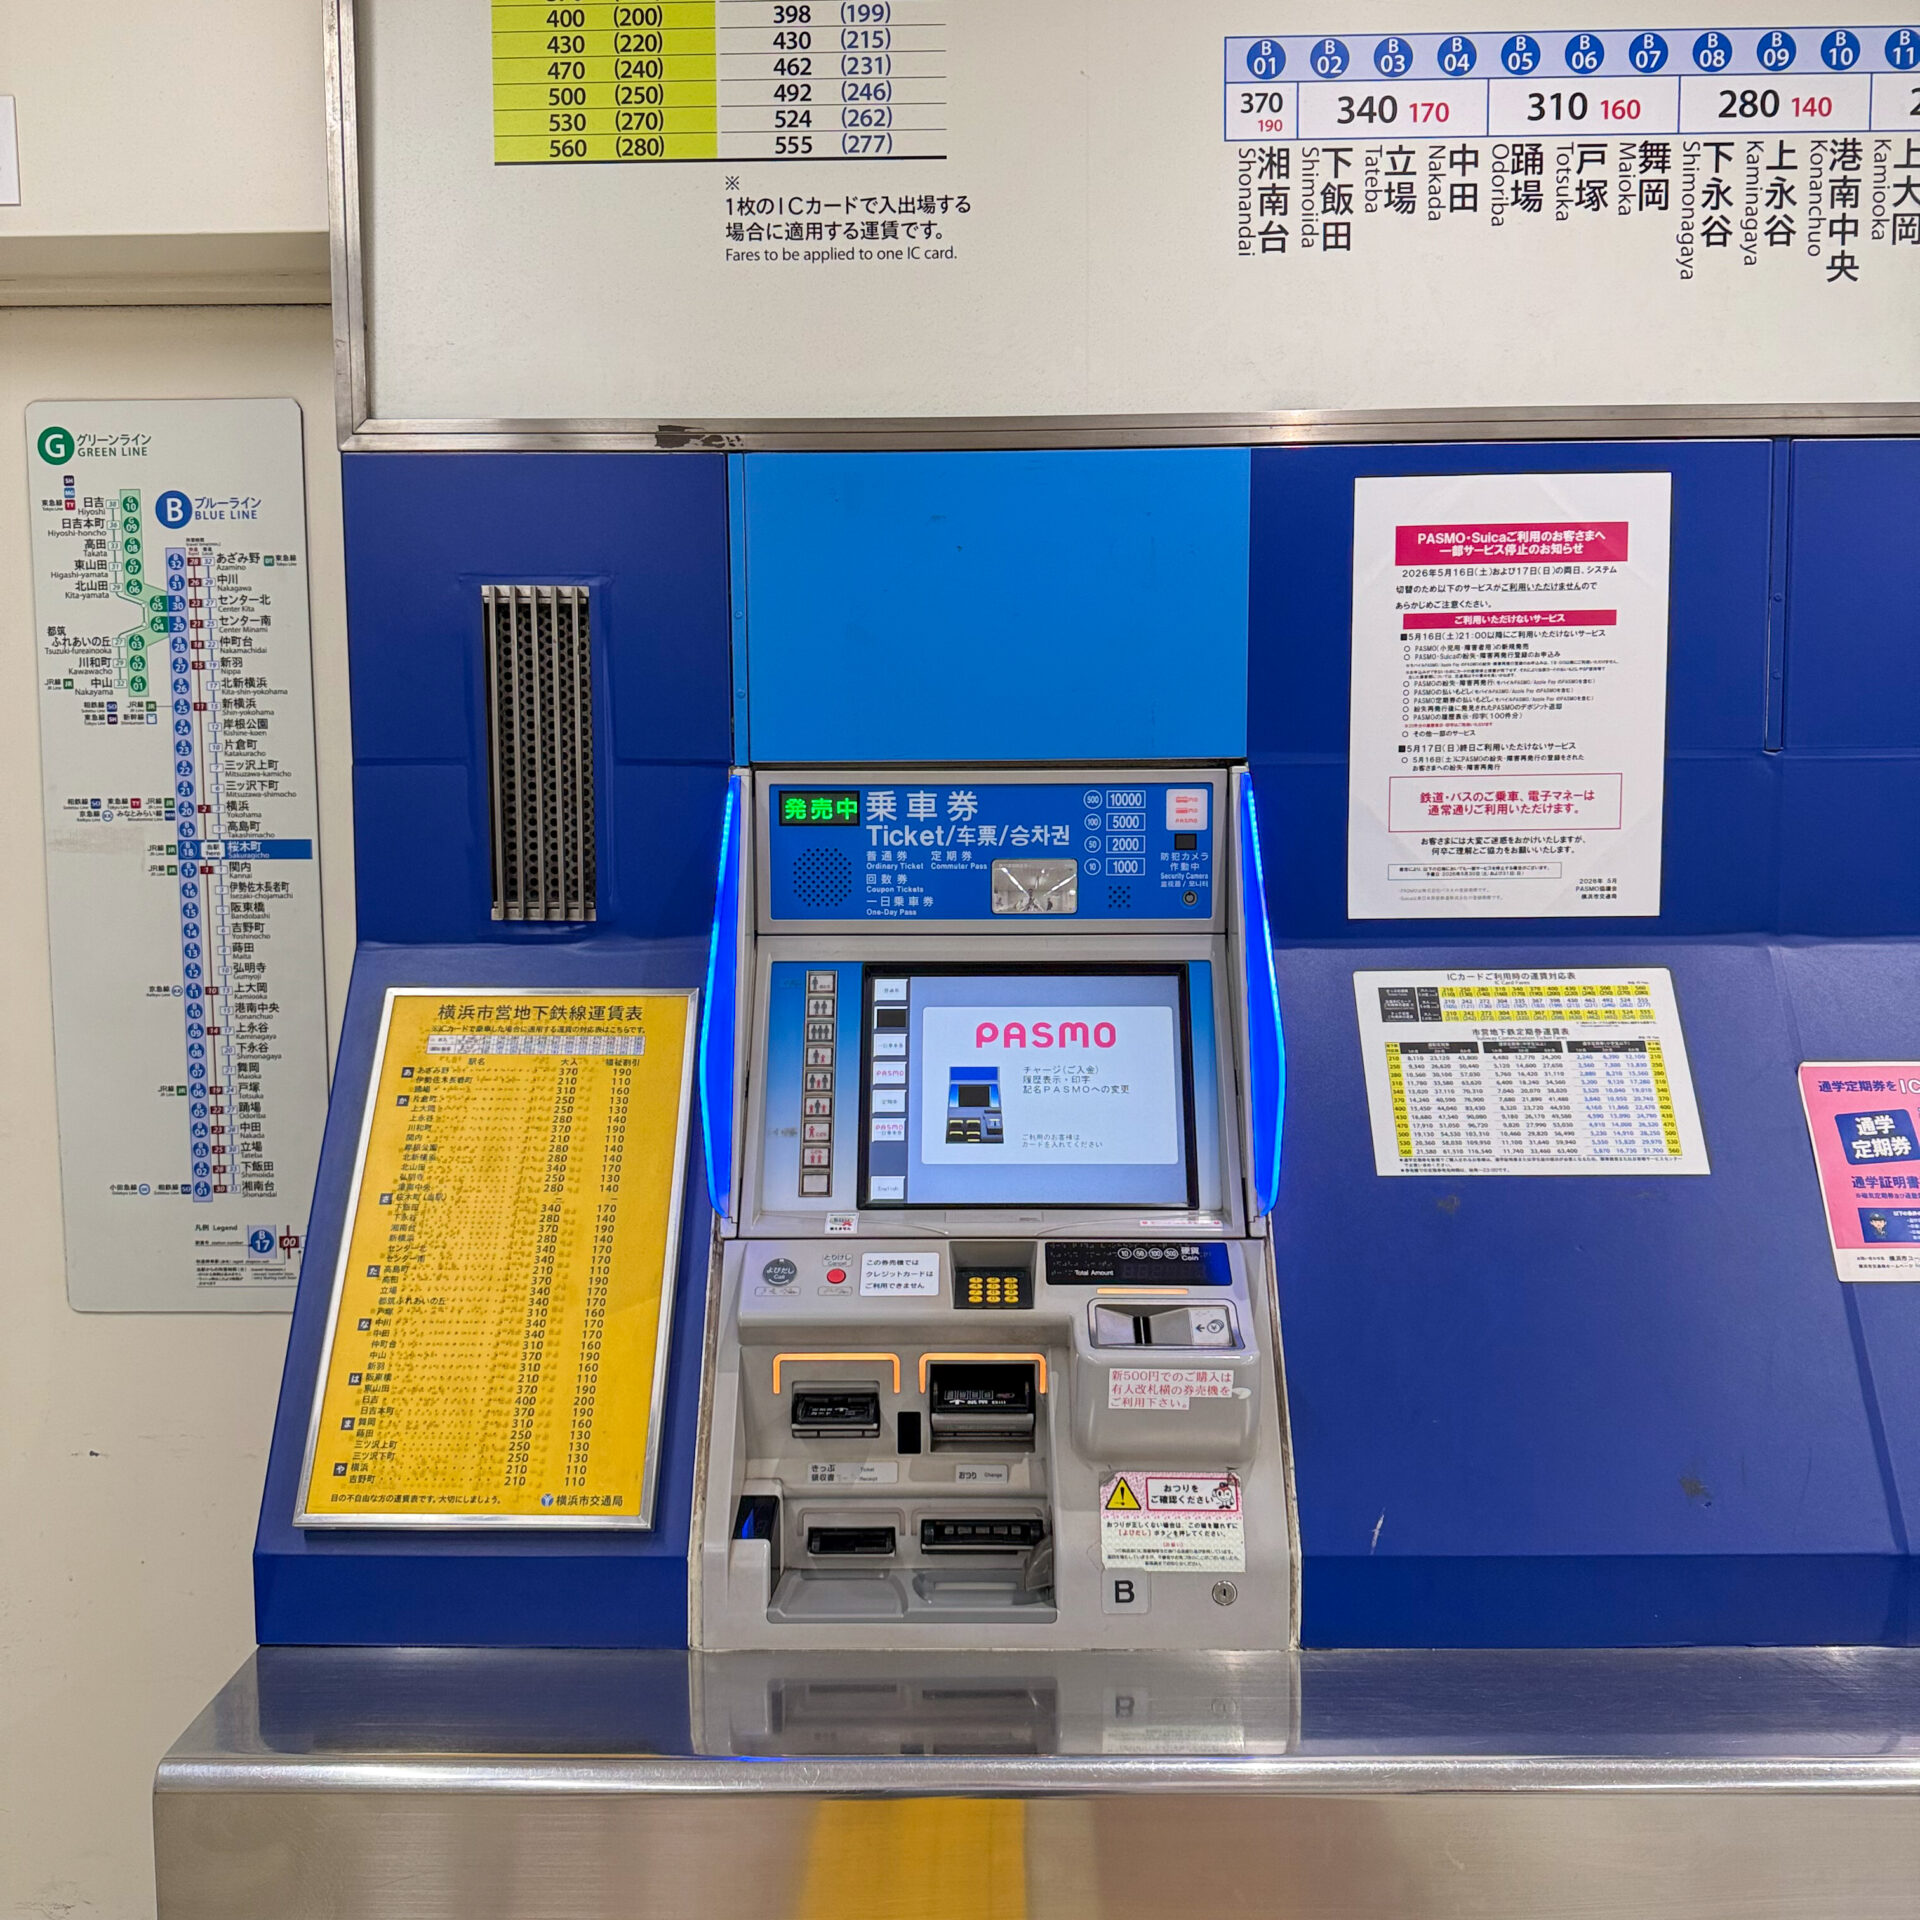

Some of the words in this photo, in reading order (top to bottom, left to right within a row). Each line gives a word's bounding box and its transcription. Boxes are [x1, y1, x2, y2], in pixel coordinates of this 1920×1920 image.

[546, 9, 585, 27] 400
[613, 8, 663, 27] (200)
[773, 5, 811, 23] 398
[840, 3, 891, 23] (199)
[1253, 58, 1276, 75] 01
[1317, 58, 1342, 74] 02
[1380, 57, 1405, 73] 03
[1508, 54, 1533, 70] 05
[1240, 92, 1283, 113] 370
[1337, 95, 1398, 123] 340
[1409, 103, 1449, 122] 170
[1527, 92, 1588, 120] 310
[1600, 99, 1641, 119] 160
[1718, 89, 1779, 118] 280
[1792, 97, 1832, 117] 140
[1258, 119, 1282, 132] 190
[549, 140, 587, 158] 560
[616, 138, 664, 158] (280)
[775, 137, 813, 154] 555
[842, 134, 892, 154] (277)
[1365, 145, 1383, 213] Tateba
[1449, 144, 1479, 213] 中田
[1575, 142, 1608, 212] 戸塚
[1618, 142, 1636, 216] Maioka
[1638, 141, 1671, 212] 舞岡
[1492, 144, 1509, 227] Odoriba
[1871, 139, 1891, 240] Kamiooka
[1258, 146, 1290, 253] 湘南台
[1320, 147, 1353, 251] 下飯田
[1701, 141, 1734, 247] 下永谷
[1764, 140, 1798, 247] 上永谷
[1807, 140, 1827, 257] Konanchuo
[725, 196, 971, 216] 1枚のICカードで入出場する
[1238, 148, 1256, 256] Shonandai
[1740, 141, 1764, 266] Kaminagaya
[1677, 141, 1700, 280] Shimonagaya
[1826, 138, 1863, 283] 港南中央
[725, 220, 945, 241] 場合に適用する運賃です。
[725, 247, 760, 262] Fares
[764, 247, 776, 262] to
[780, 247, 798, 262] be
[804, 247, 857, 264] applied
[860, 247, 872, 262] to
[876, 247, 903, 262] one
[907, 247, 920, 260] IC
[925, 247, 957, 261] card.
[45, 433, 65, 458] G
[77, 434, 151, 446] グリーンライン
[77, 447, 117, 457] GREEN
[121, 447, 148, 456] LINE
[84, 497, 104, 508] 日吉
[195, 497, 261, 509] ブルーライン
[78, 508, 105, 516] Hiyoshi
[166, 498, 183, 522] B
[195, 511, 225, 520] BLUE
[230, 510, 258, 520] LINE
[62, 518, 105, 529] 日吉本町
[48, 530, 107, 538] Hiyoshi-honcho
[1418, 530, 1606, 544] PASMO・Suicaご利用のお客さまへ
[1439, 543, 1584, 557] 一部サービス停止のお知らせ
[74, 559, 107, 570] 東山田
[216, 552, 260, 564] あざみ野
[1396, 582, 1597, 594] 切替のため以下のサービスがご利用いただけませんので
[218, 594, 271, 605] センター北
[1395, 600, 1492, 610] あらかじめご注意ください。
[1454, 614, 1566, 625] ご利用いただけないサービス
[52, 637, 111, 647] ふれあいの丘
[91, 677, 112, 688] 中山
[222, 698, 256, 709] 新横浜
[1087, 796, 1099, 804] 500
[1110, 793, 1142, 806] 10000
[1420, 790, 1595, 803] 鉄道・バスのご乗車、電子マネーは
[226, 800, 249, 811] 横浜
[784, 797, 858, 820] 発売中
[866, 790, 979, 822] 乗車券
[1428, 803, 1580, 816] 通常通りご利用いただけます。
[1088, 818, 1098, 826] 100
[1113, 816, 1139, 829] 5000
[227, 841, 262, 852] 桜木町
[1112, 838, 1139, 851] 2000
[866, 850, 908, 861] 普通券
[931, 850, 972, 861] 定期券
[1161, 852, 1209, 861] 防犯カメラ
[1113, 860, 1138, 873] 1000
[1170, 863, 1199, 871] 作動中
[866, 874, 908, 885] 回数券
[1161, 872, 1184, 880] Security
[230, 882, 290, 892] 伊勢佐木長者町
[867, 896, 934, 907] 一日乗車券
[233, 962, 266, 973] 弘明寺
[1447, 972, 1576, 981] ICカードご利用時の運賃対応表
[234, 982, 267, 993] 上大岡
[438, 1004, 643, 1021] 横浜市営地下鉄線運賃表
[976, 1022, 1116, 1048] PASMO
[468, 1058, 485, 1066] 駅名
[560, 1058, 578, 1066] 大人
[605, 1058, 640, 1067] 福祉割引
[559, 1068, 578, 1076] 370
[612, 1068, 632, 1076] 190
[1023, 1075, 1091, 1084] 履歴表示・印字
[1818, 1080, 1897, 1092] 通学定期券を
[1855, 1115, 1895, 1135] 通学
[1851, 1136, 1912, 1159] 定期券
[242, 1181, 275, 1191] 湘南台
[1181, 1246, 1200, 1255] 硬貨
[766, 1267, 795, 1275] よびだし
[866, 1270, 933, 1278] クレジットカードは
[1112, 1370, 1232, 1383] 新500円でのご購入は
[1111, 1384, 1230, 1396] 有人改札横の券売機を
[1111, 1398, 1188, 1409] ご利用下さい。
[812, 1464, 835, 1472] きっぷ
[349, 1474, 375, 1484] 吉野町
[504, 1476, 526, 1486] 210
[564, 1477, 586, 1486] 110
[812, 1473, 834, 1482] 領収書
[959, 1471, 977, 1480] おつり
[1163, 1485, 1199, 1493] おつりを
[556, 1494, 624, 1507] 横浜市交通局
[1151, 1496, 1214, 1504] ご確認ください
[1114, 1580, 1135, 1603] B
